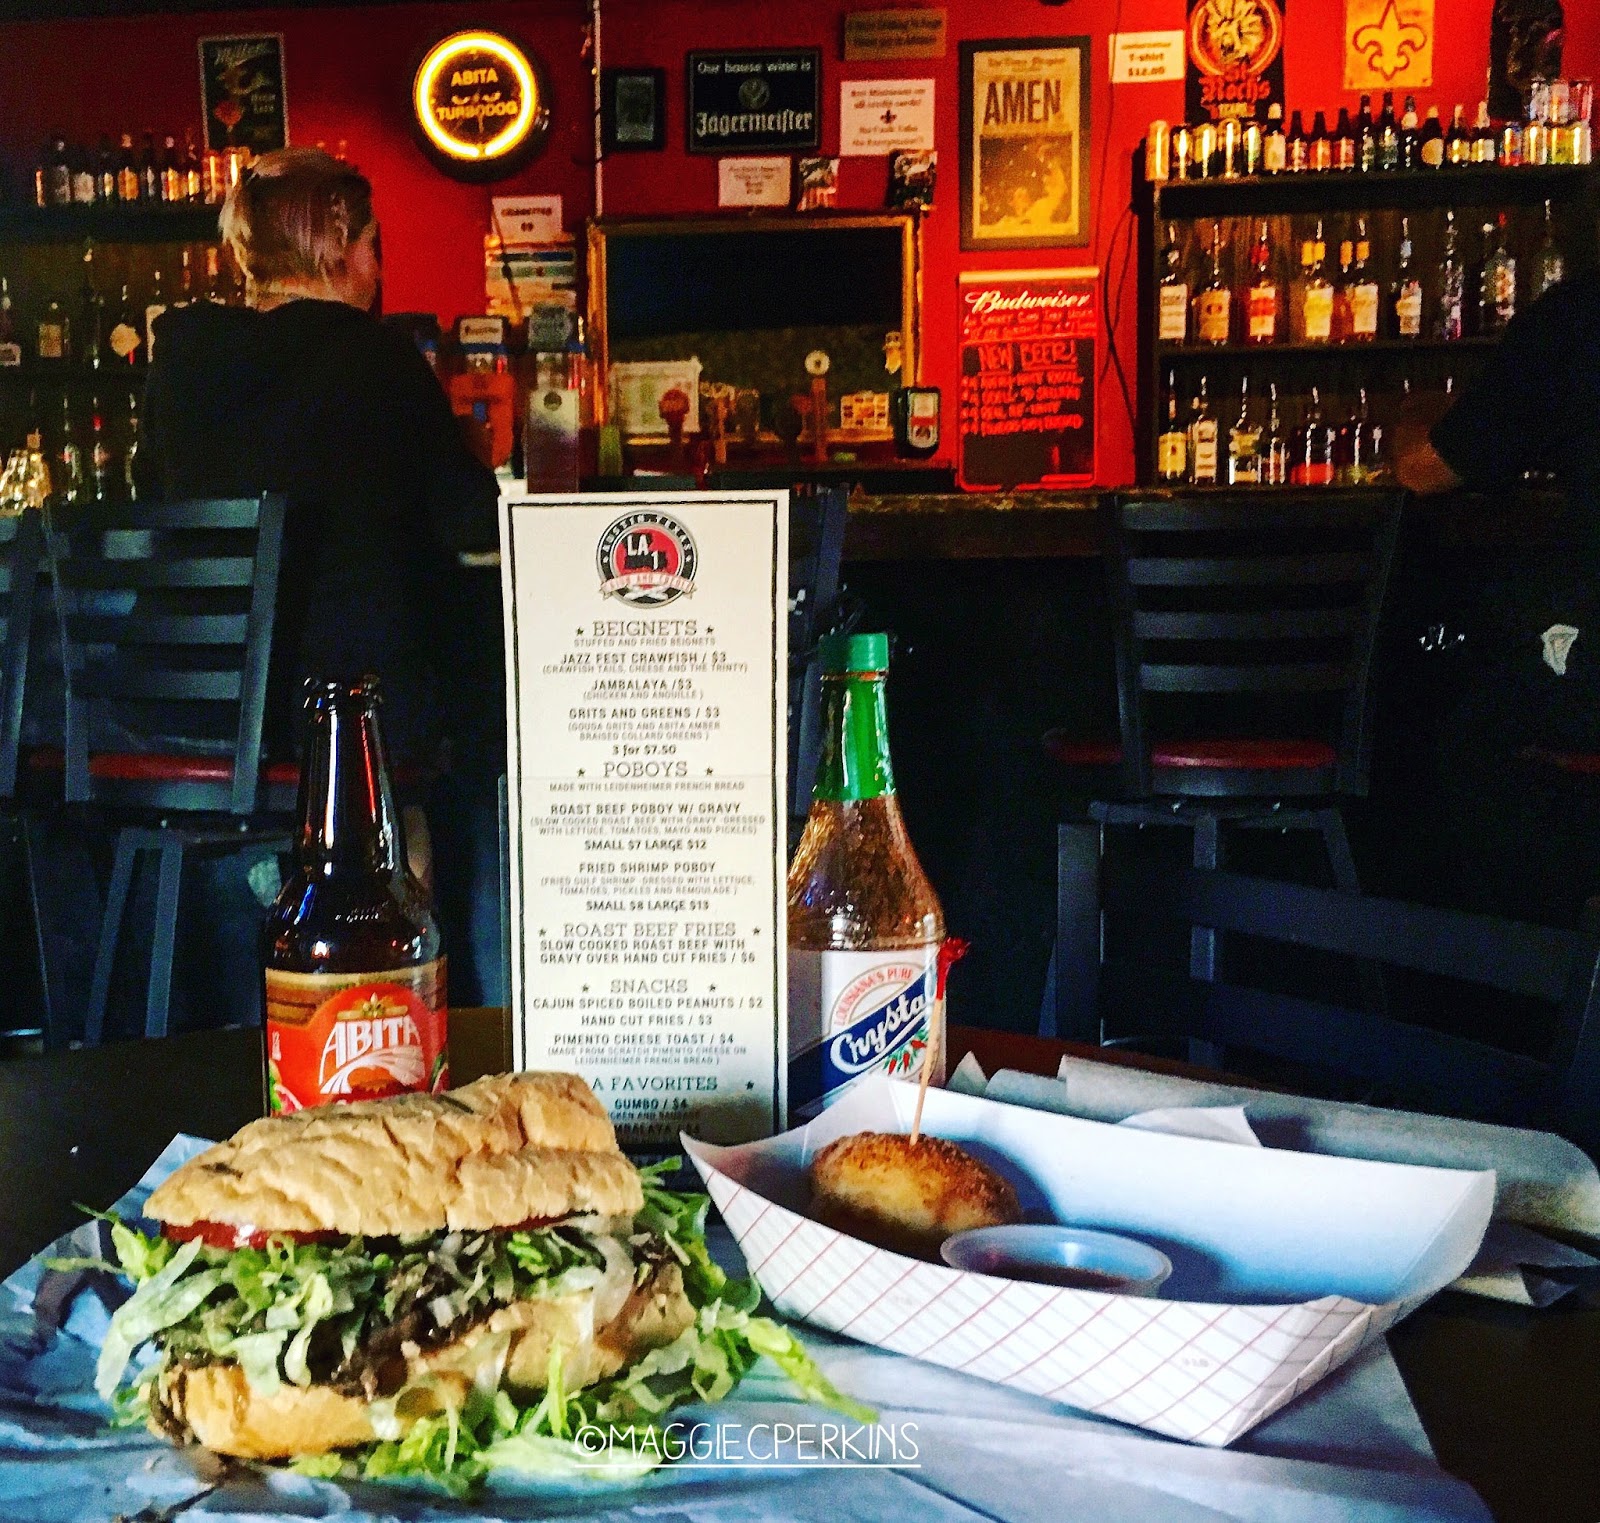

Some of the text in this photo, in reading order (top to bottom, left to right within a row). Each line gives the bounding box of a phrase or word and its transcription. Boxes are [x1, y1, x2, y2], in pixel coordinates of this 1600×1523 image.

[451, 68, 499, 87] ABITA
[983, 79, 1061, 126] AMEN
[436, 100, 519, 121] TURBODOG
[964, 289, 1091, 314] Budweiser
[627, 534, 650, 556] LA
[592, 619, 698, 637] BEIGNETS
[574, 638, 716, 647] STUFFED AND FRIED BEIGNETS
[560, 651, 727, 664] JAZZ FEST CRAWFISH $3
[628, 664, 664, 673] CHEESE
[667, 663, 687, 673] AND
[690, 663, 707, 673] THE
[592, 679, 667, 690] JAMBALAYA
[630, 691, 649, 700] AND
[569, 707, 720, 719] GRITS AND GREENS $3
[605, 722, 633, 731] GRITS
[636, 722, 655, 730] AND
[688, 721, 720, 730] AMBER
[643, 744, 677, 756] $7.50
[603, 761, 688, 778] POBOYS
[549, 783, 575, 792] MADE
[578, 783, 601, 792] WITH
[674, 782, 712, 791] FRENCH
[714, 782, 745, 791] BREAD
[550, 804, 591, 815] ROAST
[596, 804, 626, 815] BEEF
[631, 804, 673, 814] POBOY
[698, 803, 741, 814] GRAVY
[601, 816, 631, 826] ROAST
[660, 816, 683, 825] WITH
[539, 827, 562, 836] WITH
[665, 826, 691, 836] MAYO
[693, 826, 712, 836] AND
[584, 839, 708, 851] SMALL $7 LARGE $12
[579, 862, 716, 874] FRIED SHRIMP POBOY
[687, 876, 710, 886] WITH
[653, 886, 673, 895] AND
[586, 901, 627, 911] SMALL
[629, 900, 644, 911] $8
[647, 900, 686, 911] LARGE
[563, 923, 737, 937] ROAST BEEF FRIES
[540, 939, 746, 951] SLOW COOKED ROAST BEEF WITH
[540, 953, 582, 964] GRAVY
[586, 953, 619, 964] OVER
[623, 953, 658, 964] HAND
[662, 953, 686, 963] CUT
[691, 953, 727, 963] FRIES
[610, 979, 689, 994] SNACKS
[532, 998, 575, 1009] CAJUN
[578, 998, 624, 1009] SPICED
[628, 998, 673, 1009] BOILED
[677, 997, 735, 1009] PEANUTS
[748, 997, 764, 1008] $2
[581, 1015, 616, 1026] HAND
[620, 1015, 644, 1026] CUT
[648, 1015, 685, 1026] FRIES
[698, 1015, 713, 1025] $3
[554, 1034, 610, 1045] PIMENTO
[614, 1034, 662, 1045] CHEESE
[666, 1034, 706, 1044] TOAST
[719, 1034, 734, 1044] $4
[830, 993, 928, 1074] Crysta
[319, 1014, 422, 1087] ABITA
[592, 1076, 718, 1091] A FAVORITES
[614, 1098, 659, 1110] GUMBO
[672, 1098, 687, 1109] $4
